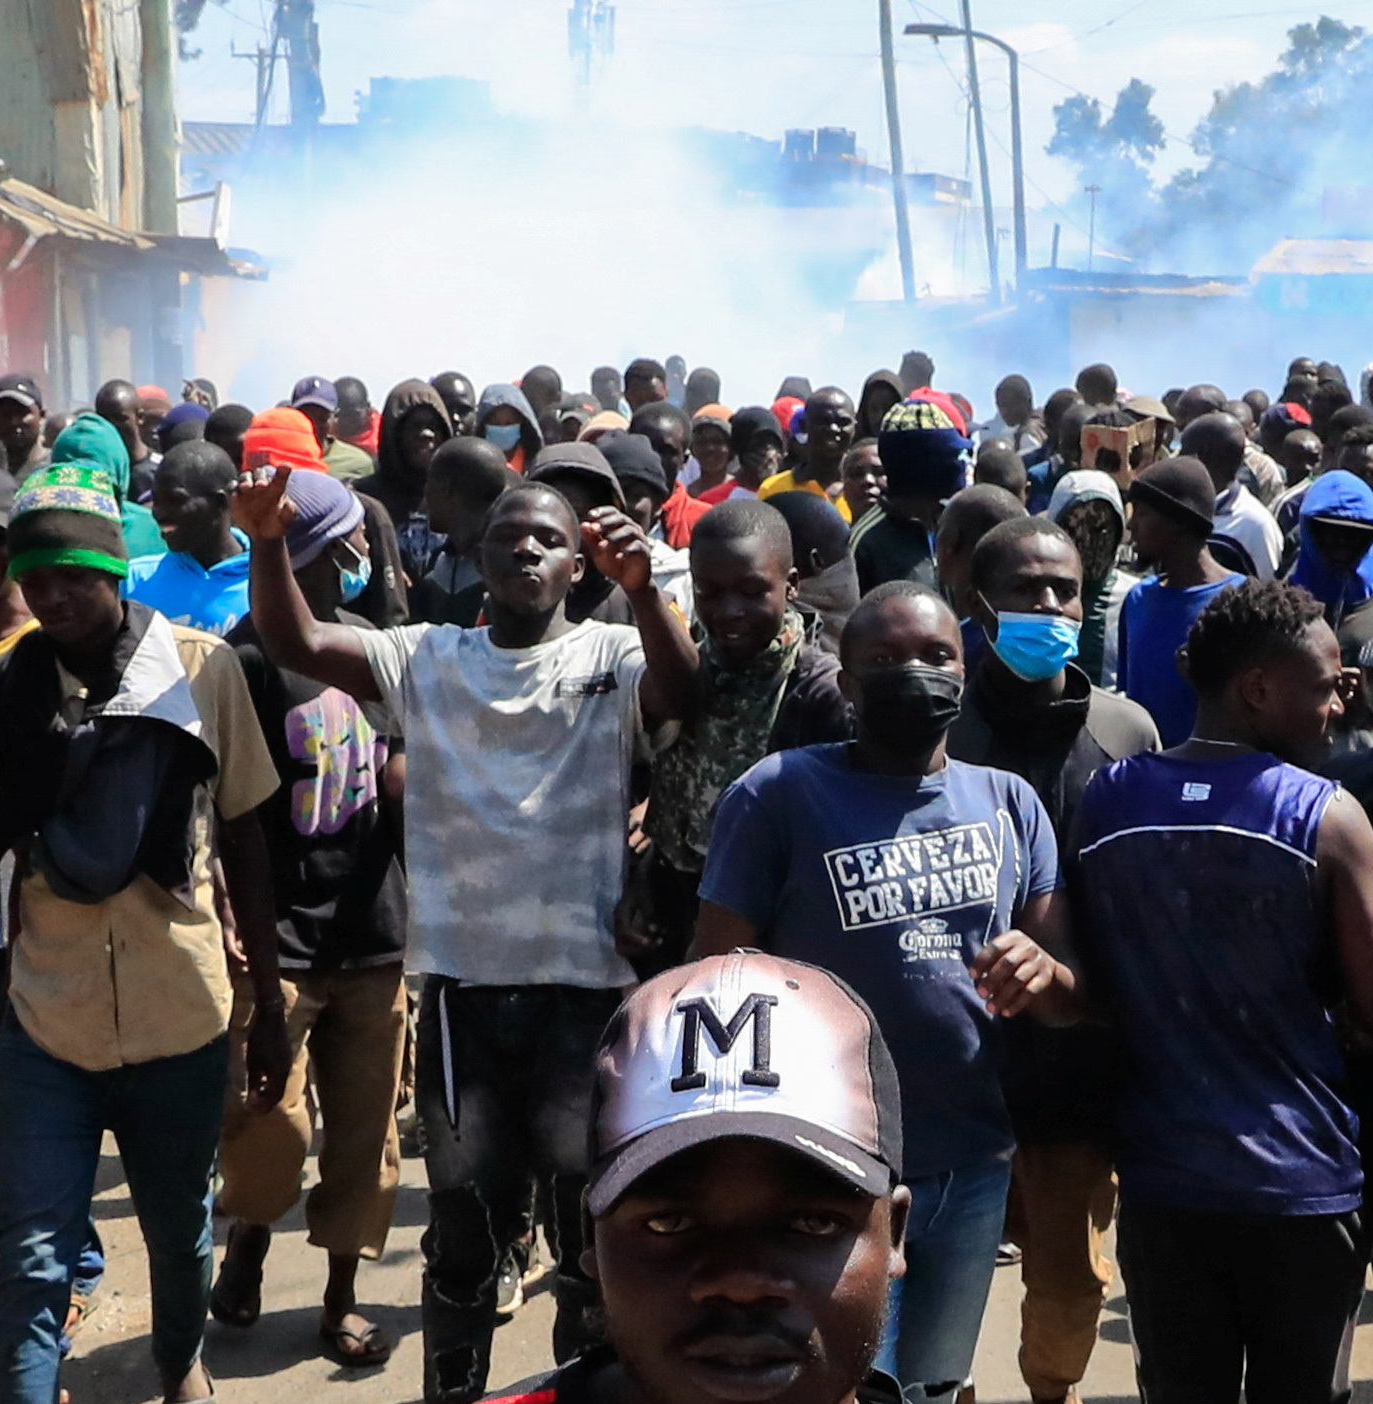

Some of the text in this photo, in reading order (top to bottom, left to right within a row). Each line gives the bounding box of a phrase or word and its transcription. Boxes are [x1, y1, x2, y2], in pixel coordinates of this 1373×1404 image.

[835, 829, 992, 887] CERVEZA
[845, 863, 996, 924] POR FAVOR
[899, 930, 963, 953] Corona
[671, 993, 780, 1092] M
